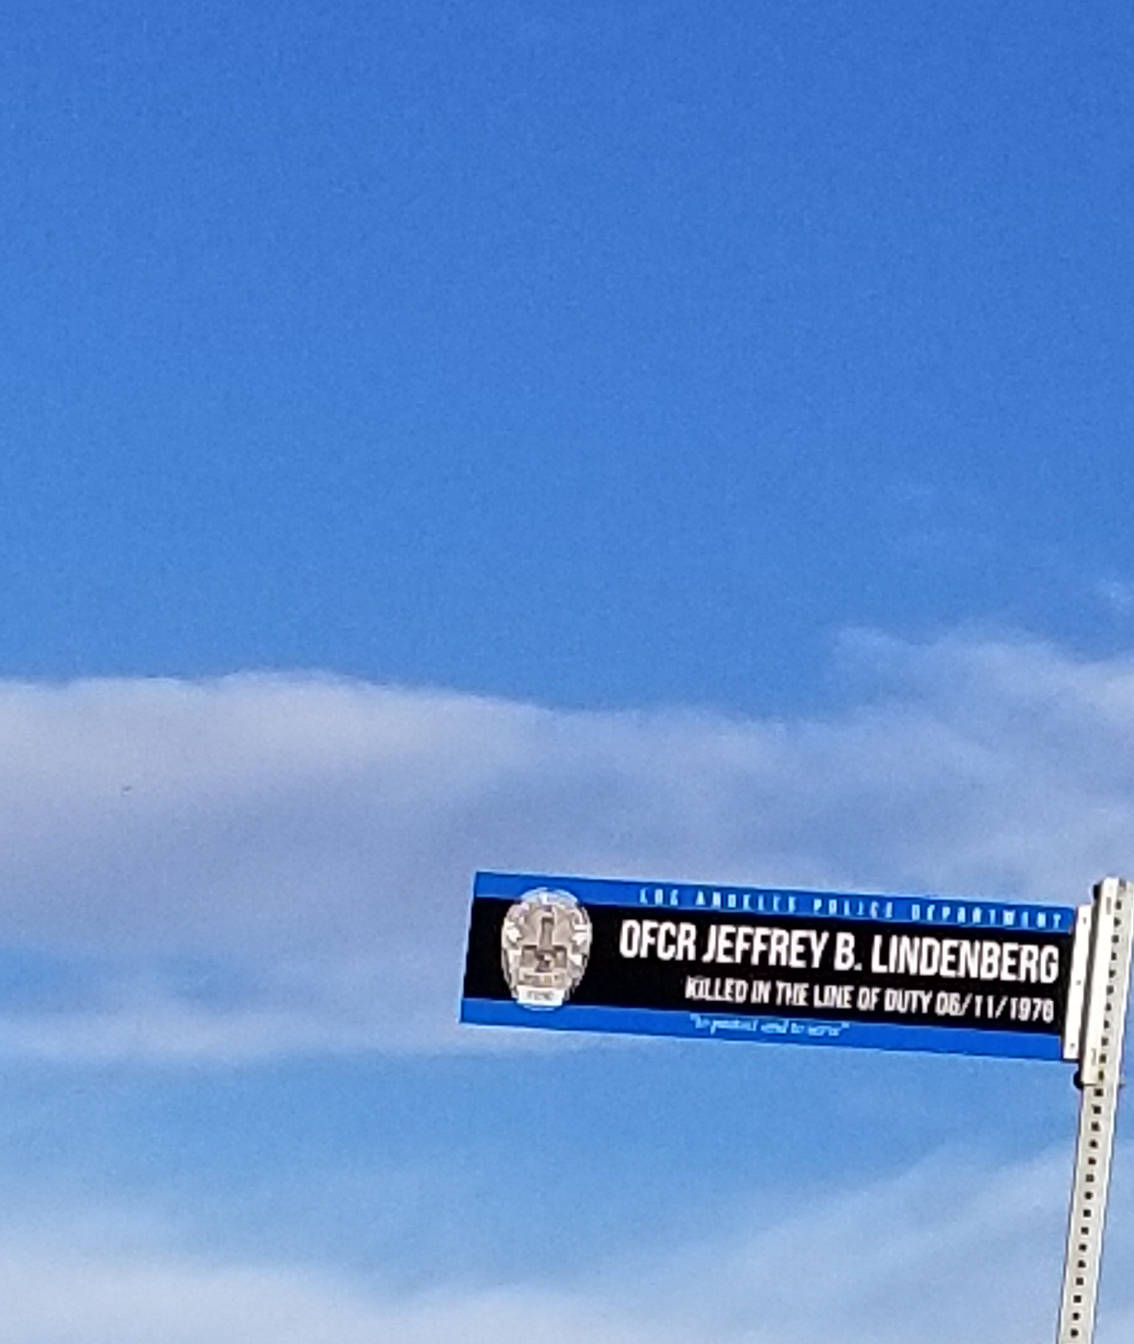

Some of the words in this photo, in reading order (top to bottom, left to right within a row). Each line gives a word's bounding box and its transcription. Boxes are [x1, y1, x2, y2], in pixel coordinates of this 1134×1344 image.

[640, 888, 679, 906] LOS
[813, 898, 893, 919] POLICE
[911, 904, 1062, 929] DEPARTMENT
[620, 919, 697, 961] OFCR
[702, 924, 830, 968] JEFFREY
[834, 931, 862, 971] B.
[871, 934, 1060, 984] LINDENBERG
[685, 975, 749, 1003] KILLED
[751, 979, 772, 1003] IN
[776, 979, 810, 1006] THE
[813, 984, 855, 1008] LINE
[857, 985, 881, 1011] OF
[884, 988, 933, 1013] DUTY
